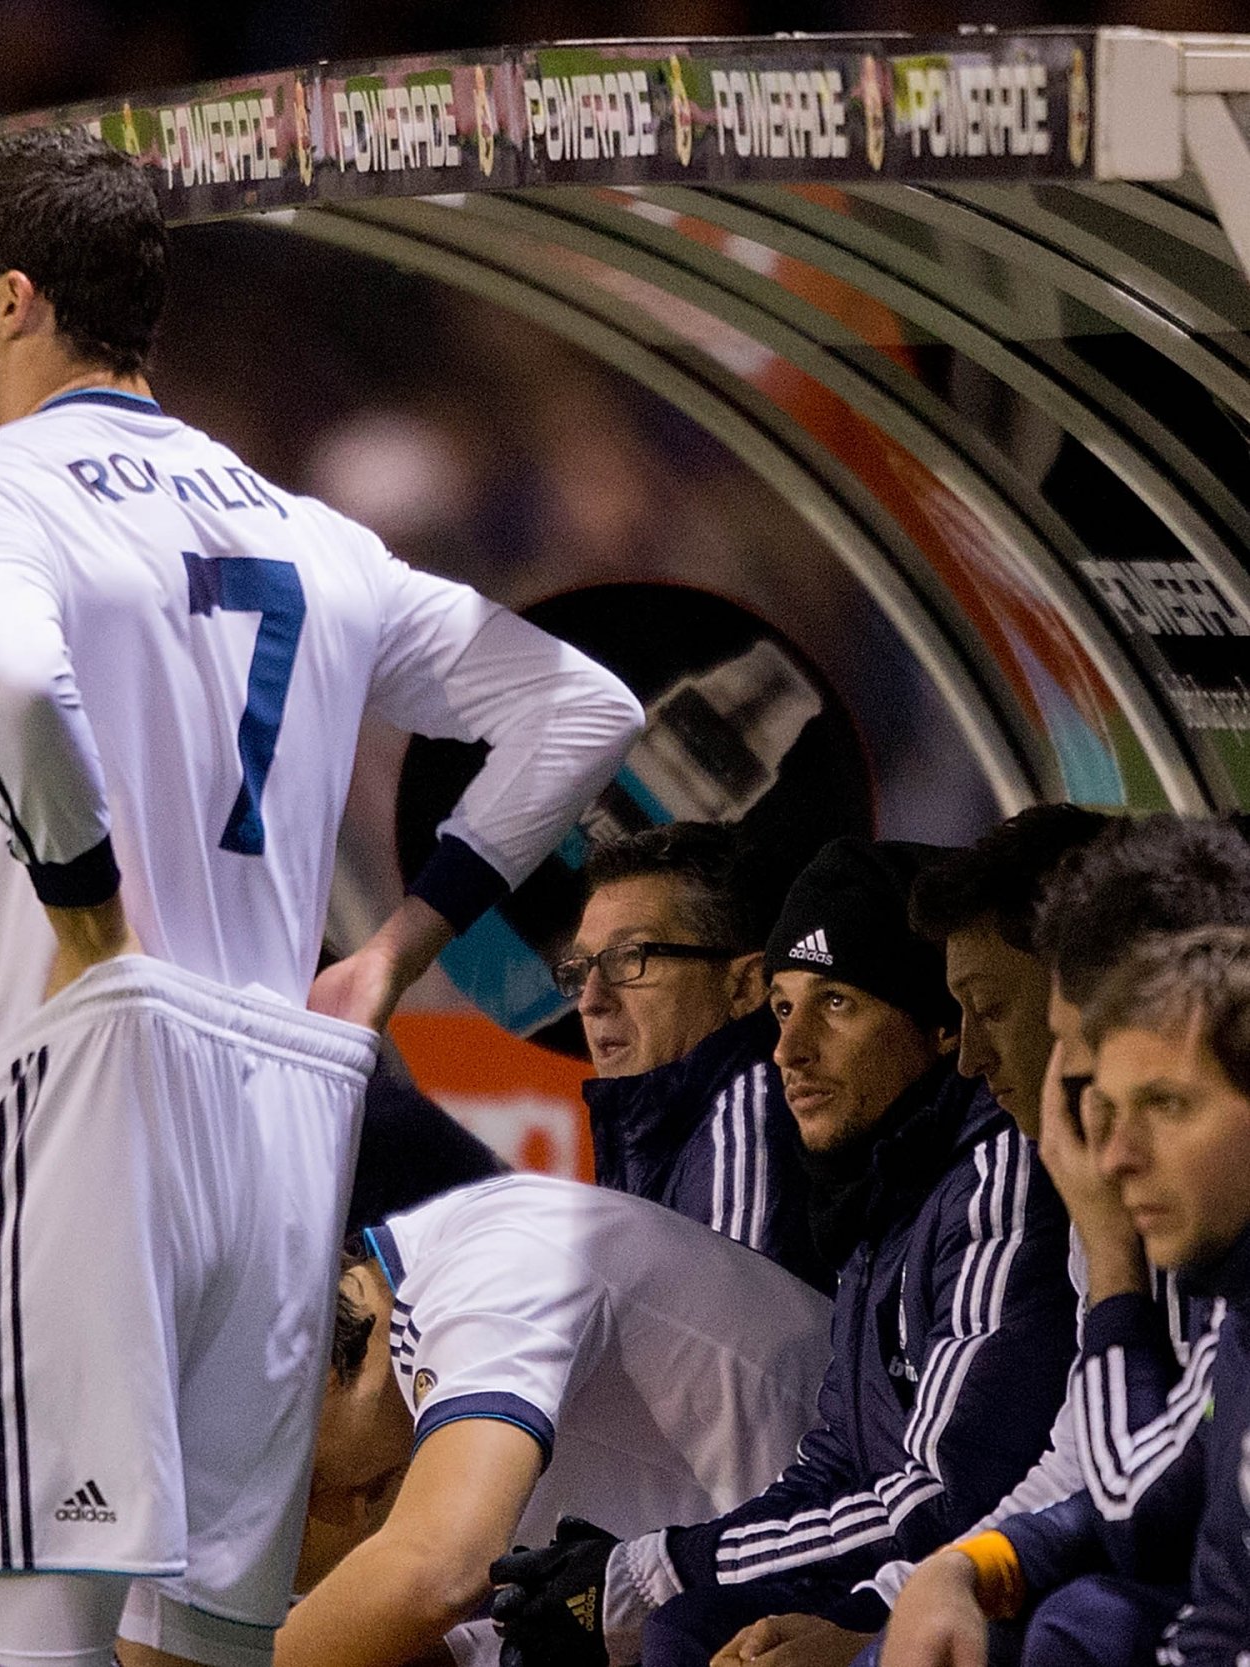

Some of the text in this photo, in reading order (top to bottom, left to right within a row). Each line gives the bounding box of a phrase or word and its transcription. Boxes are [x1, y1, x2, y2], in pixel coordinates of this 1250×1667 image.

[160, 98, 281, 190] POWERADE
[333, 84, 460, 173] POWERADE
[524, 70, 656, 160] POWERADE
[711, 70, 848, 158] POWERADE
[907, 65, 1050, 158] POWERADE
[67, 453, 289, 519] ROALD
[1076, 561, 1250, 636] POWERAD
[182, 551, 307, 856] 7
[788, 947, 833, 966] adidas
[55, 1508, 117, 1524] adidas
[586, 1586, 597, 1631] adidas
